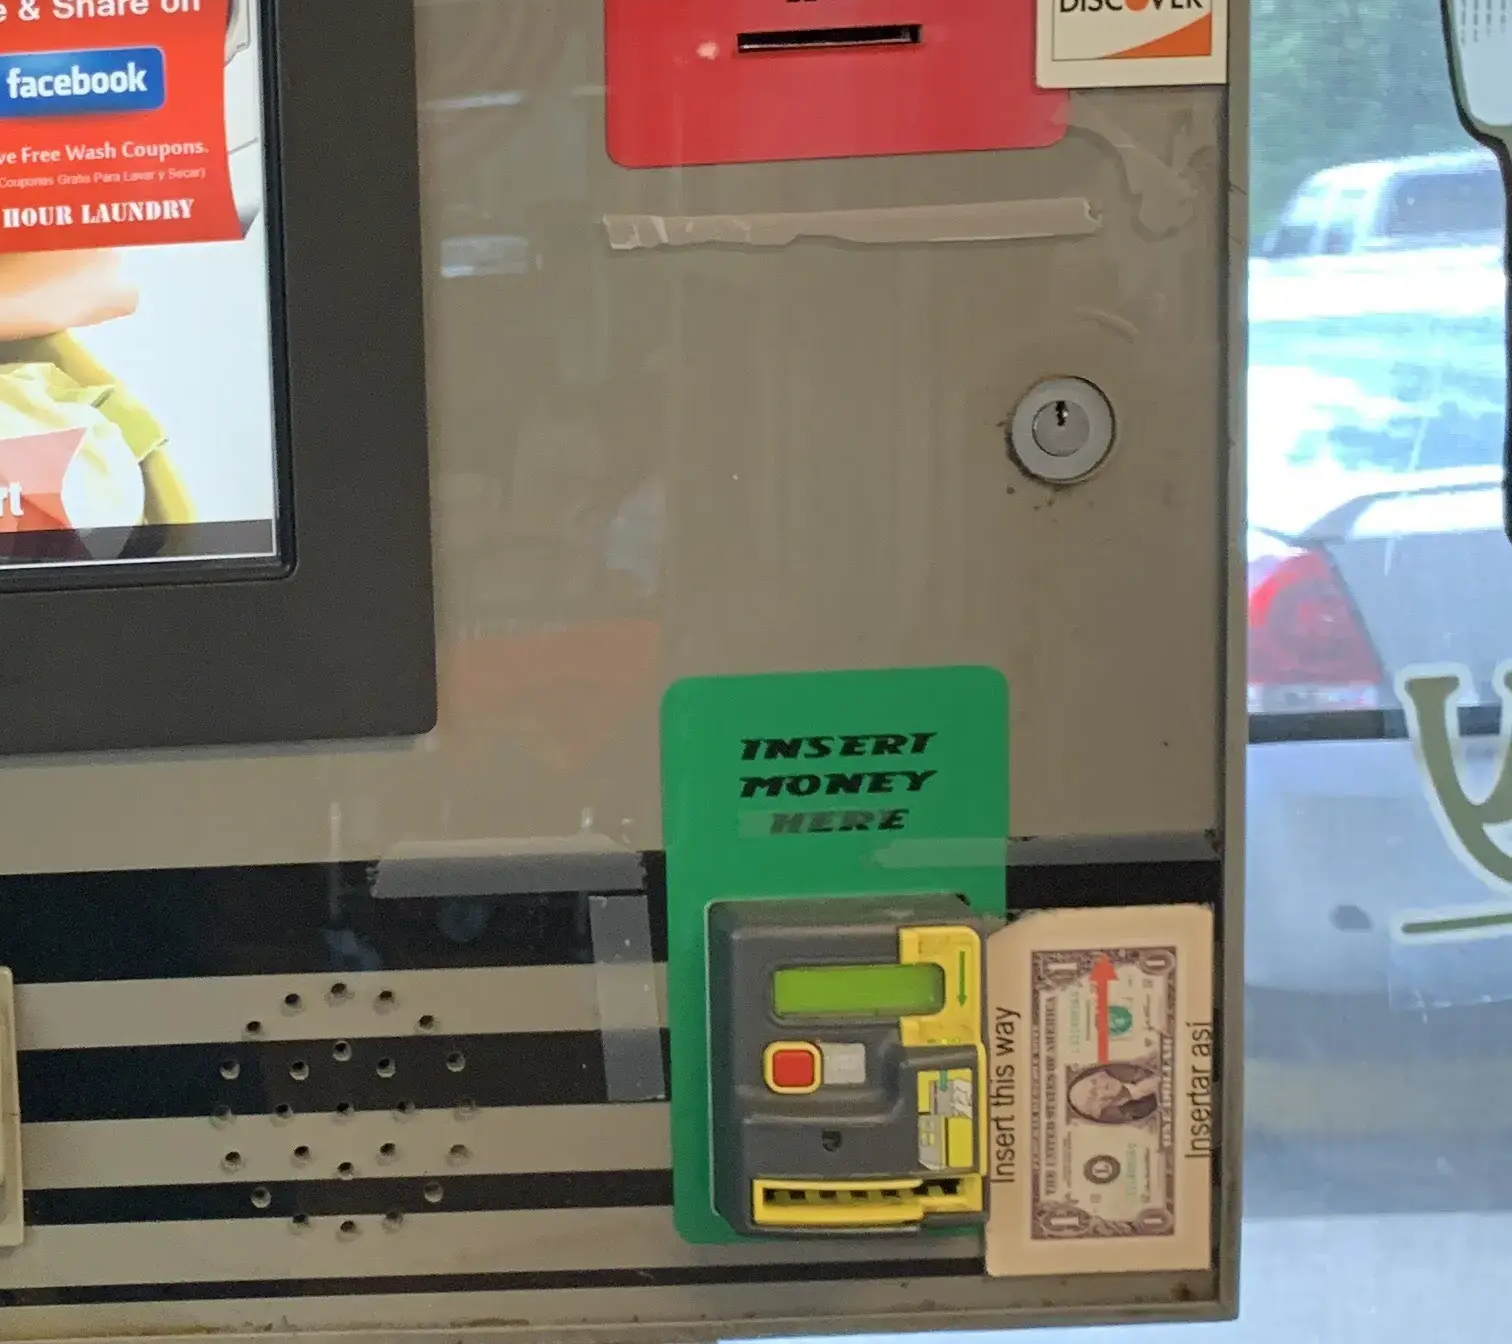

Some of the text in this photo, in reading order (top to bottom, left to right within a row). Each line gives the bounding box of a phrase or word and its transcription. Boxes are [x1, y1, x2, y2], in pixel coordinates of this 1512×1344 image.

[6, 61, 148, 99] facebook
[20, 146, 61, 164] Free
[64, 140, 117, 161] Wash
[121, 140, 209, 162] Coupons.
[2, 205, 73, 228] HOUR
[81, 198, 194, 224] LAUNDRY
[739, 731, 938, 762] INSERT
[739, 769, 938, 798] MONEY
[769, 808, 910, 836] HERE
[990, 1006, 1021, 1184] Insert this way
[1184, 1065, 1212, 1159] Insertar
